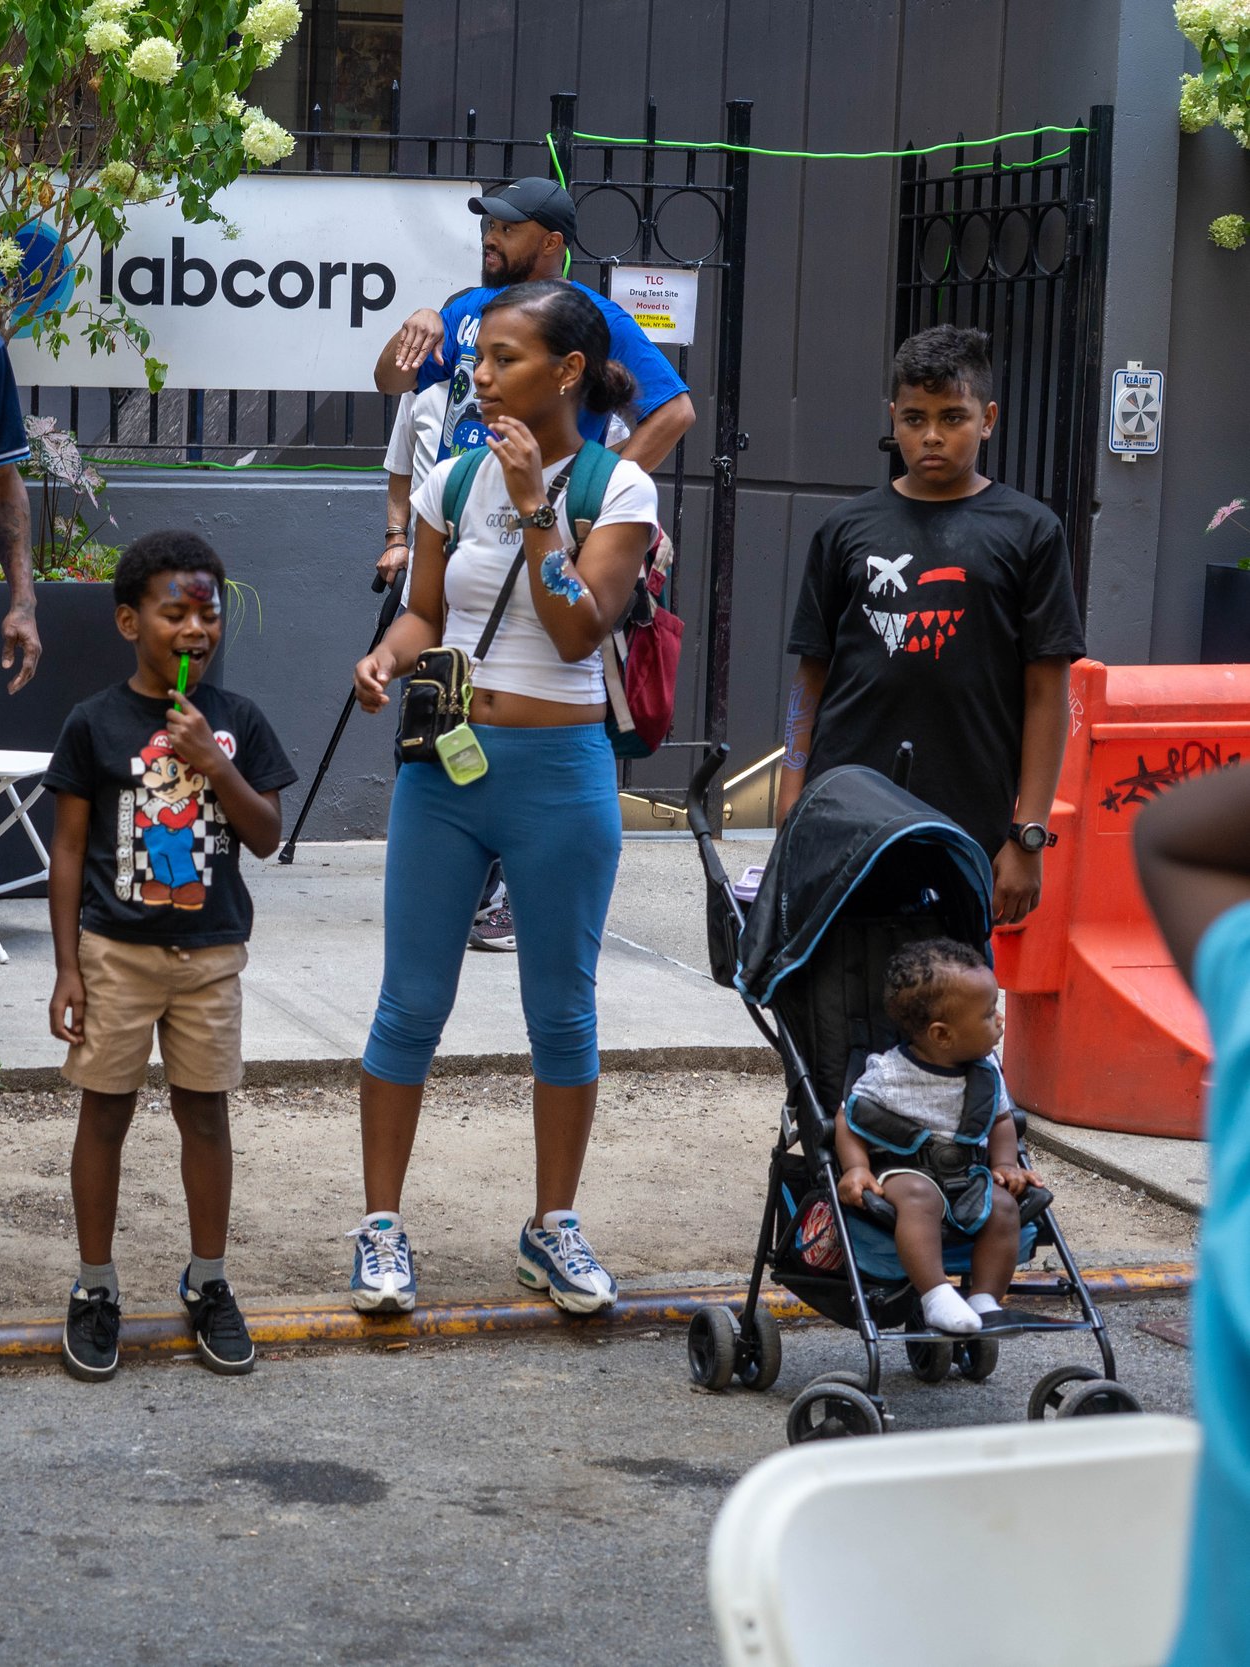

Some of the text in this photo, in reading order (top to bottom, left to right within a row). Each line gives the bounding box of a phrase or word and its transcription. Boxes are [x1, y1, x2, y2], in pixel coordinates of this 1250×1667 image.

[100, 236, 397, 328] labcorp
[645, 276, 664, 285] TLC
[630, 288, 679, 298] Drug Test Site
[636, 302, 661, 310] Moved
[499, 531, 521, 545] GOD
[115, 790, 135, 901] SUPER MARIO
